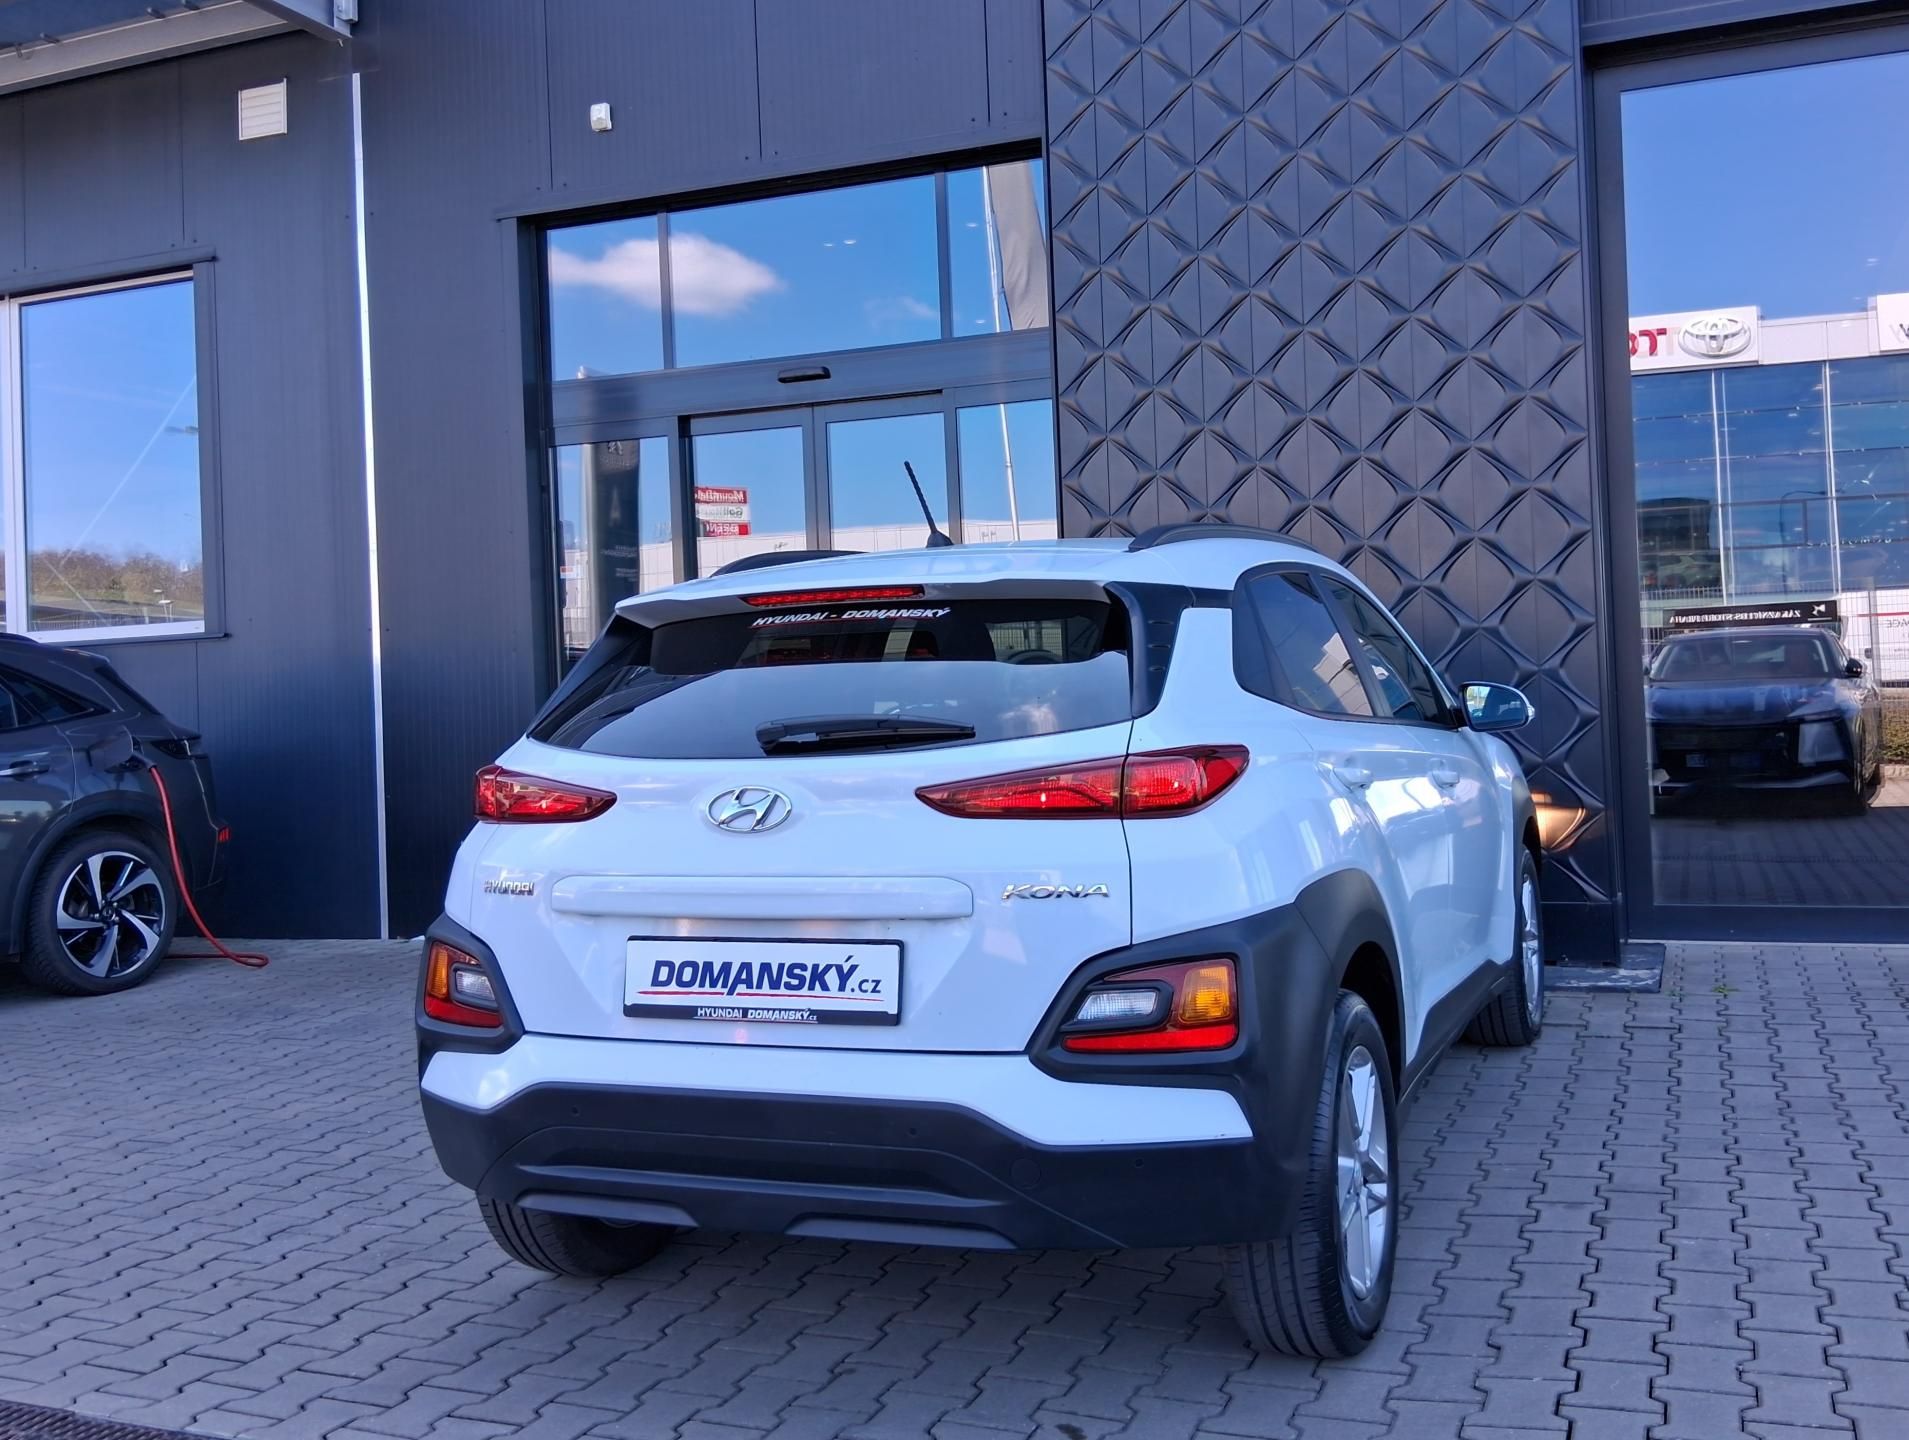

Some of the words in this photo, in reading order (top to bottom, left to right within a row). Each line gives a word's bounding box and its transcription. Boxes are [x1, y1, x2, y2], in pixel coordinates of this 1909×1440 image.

[752, 612, 827, 626] HYUNDAI
[841, 607, 951, 619] DOMANSKÝ
[484, 880, 535, 896] HYUNDAI
[1001, 884, 1110, 900] KONA
[697, 1007, 743, 1018] HYUNDAI
